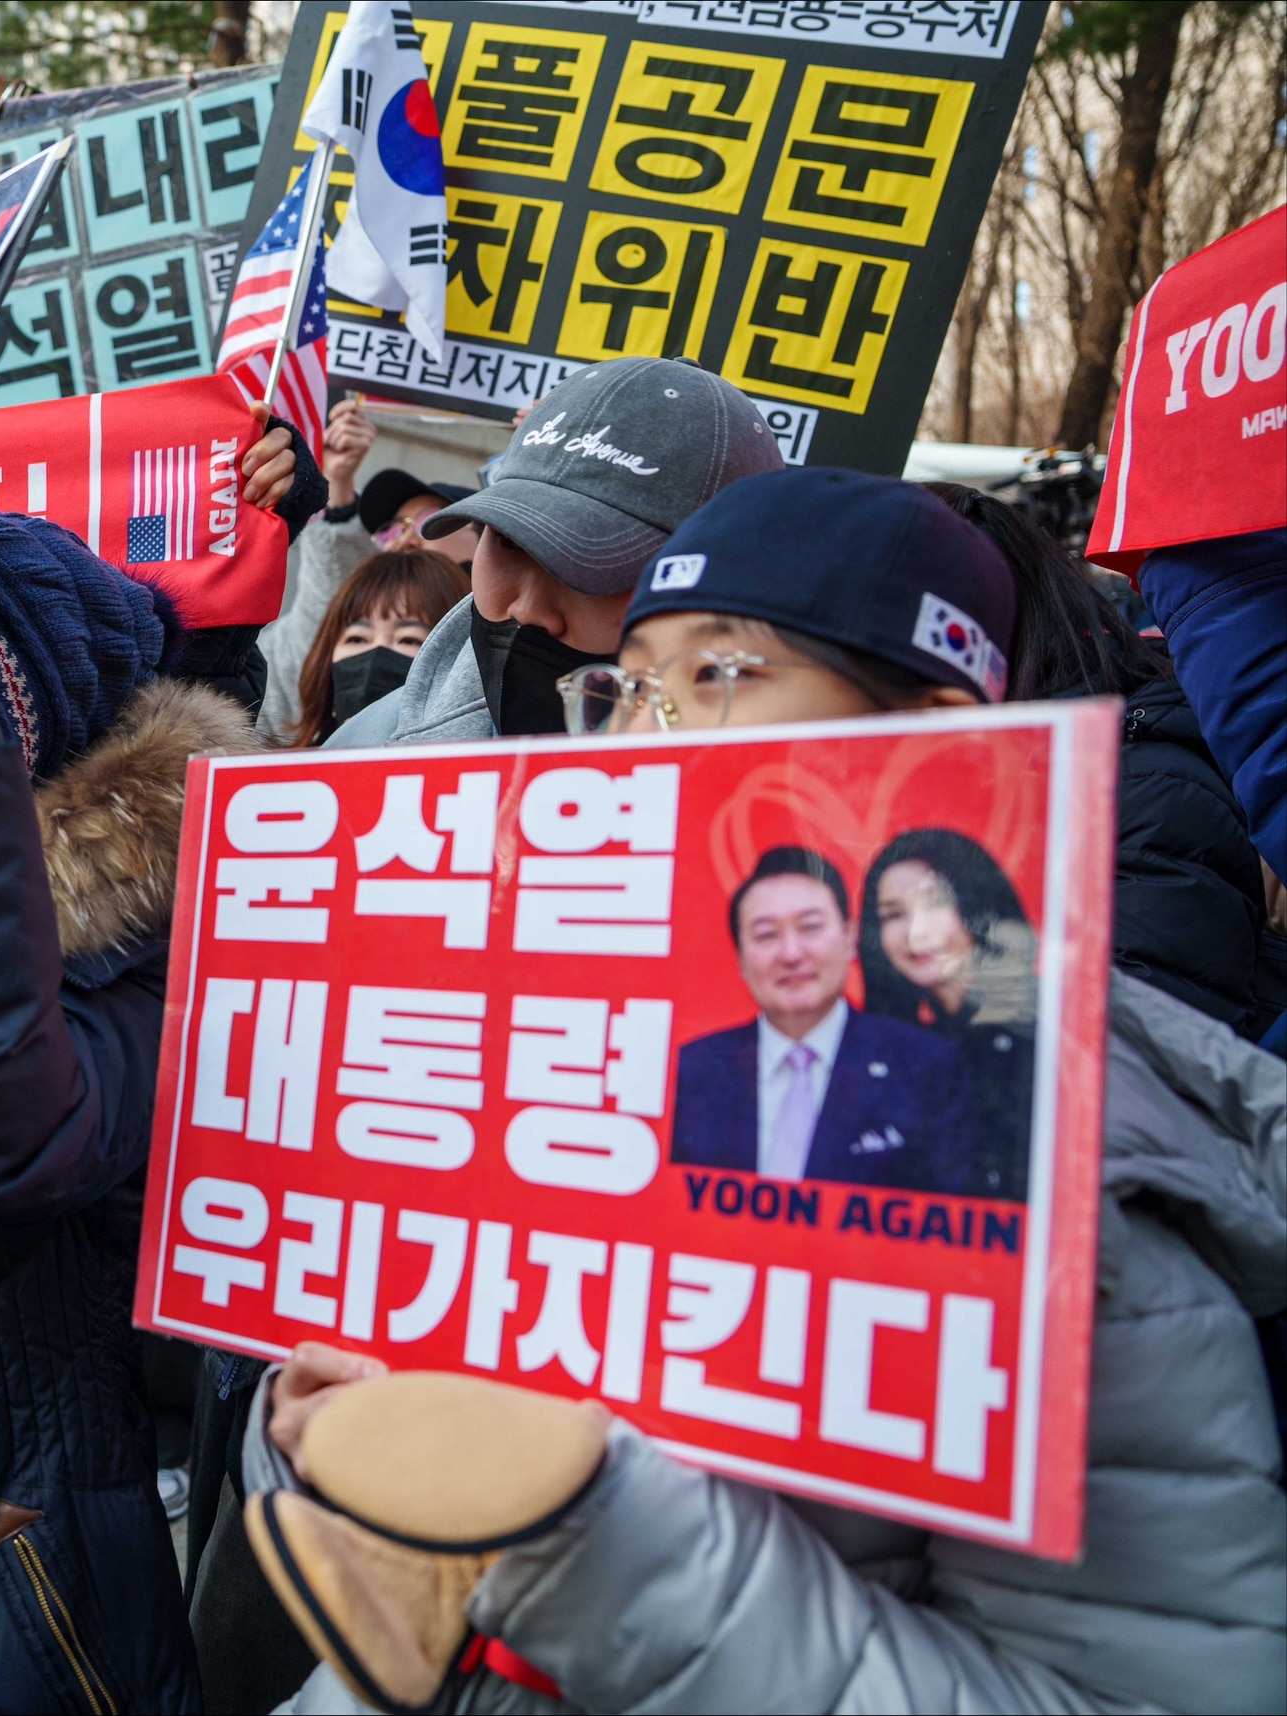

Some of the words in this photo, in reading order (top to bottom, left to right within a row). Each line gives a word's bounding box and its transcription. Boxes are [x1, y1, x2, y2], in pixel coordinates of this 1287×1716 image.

[419, 32, 942, 228] 풀공문
[325, 184, 891, 398] 차위반
[1165, 281, 1287, 415] YOO
[208, 437, 239, 558] AGAIN
[213, 761, 682, 958] 윤석열
[191, 976, 674, 1197] 대통령
[685, 1173, 821, 1228] YOON
[837, 1194, 1022, 1257] AGAIN
